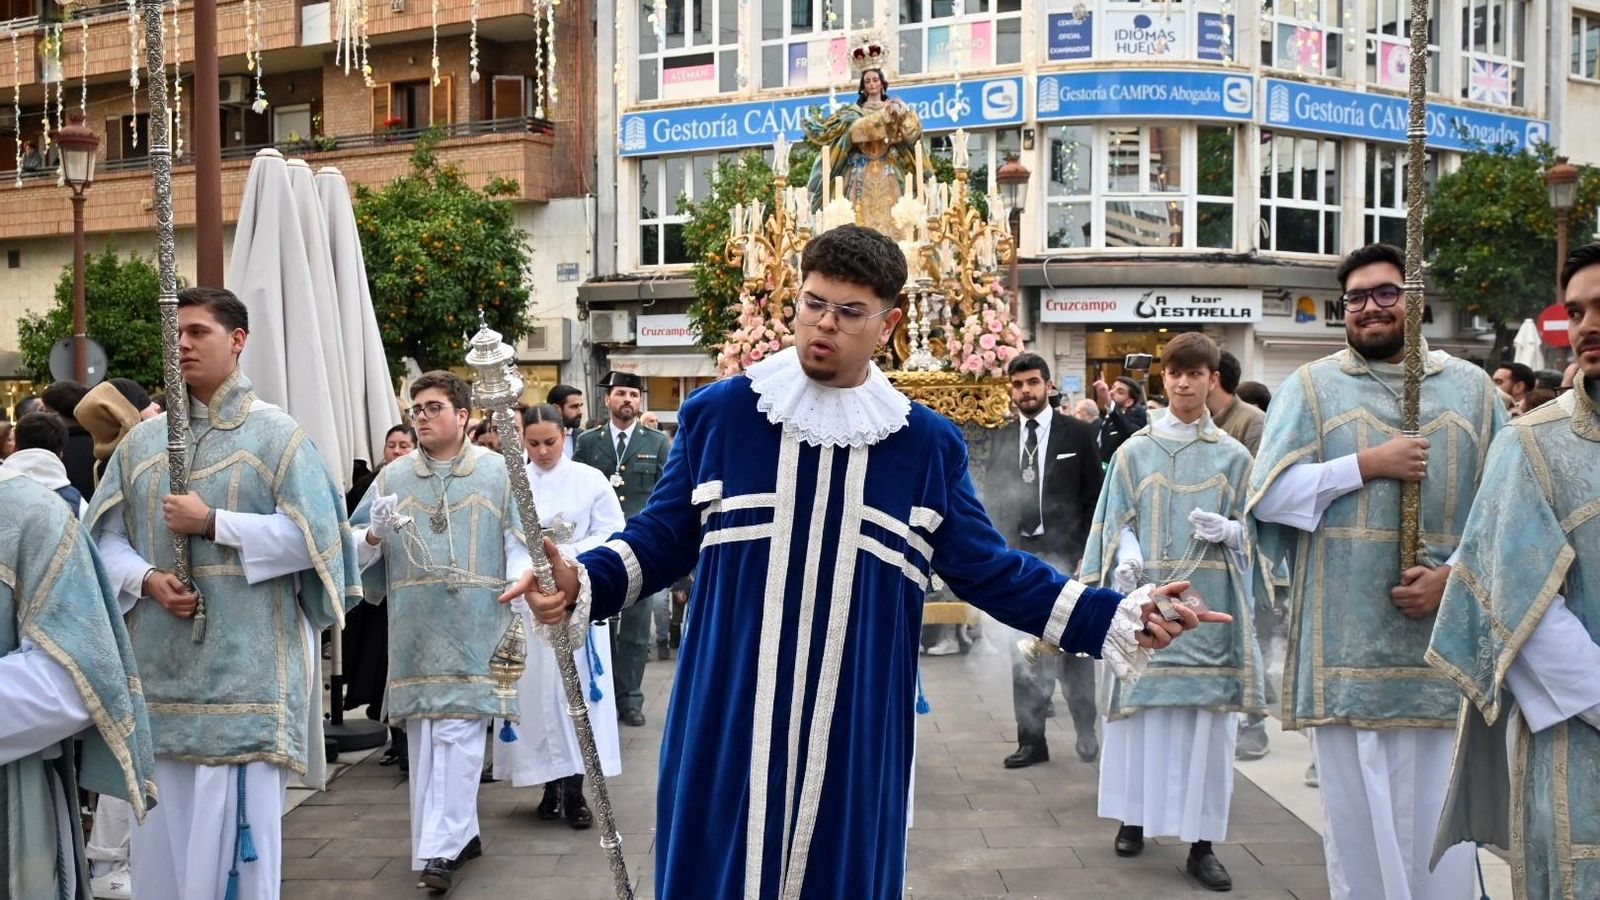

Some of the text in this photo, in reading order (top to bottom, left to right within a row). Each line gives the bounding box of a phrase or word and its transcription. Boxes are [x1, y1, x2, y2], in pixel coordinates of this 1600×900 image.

[1114, 28, 1176, 43] IDIOMAS
[1060, 84, 1221, 105] Gestoría CAMPOS Abogados
[1295, 92, 1365, 127] Gestoría
[1369, 103, 1446, 138] CAMOS
[653, 112, 738, 143] Gestoría
[1045, 298, 1117, 313] Cruzcampo
[1191, 295, 1222, 304] bar
[1160, 307, 1251, 318] ESTRELLA
